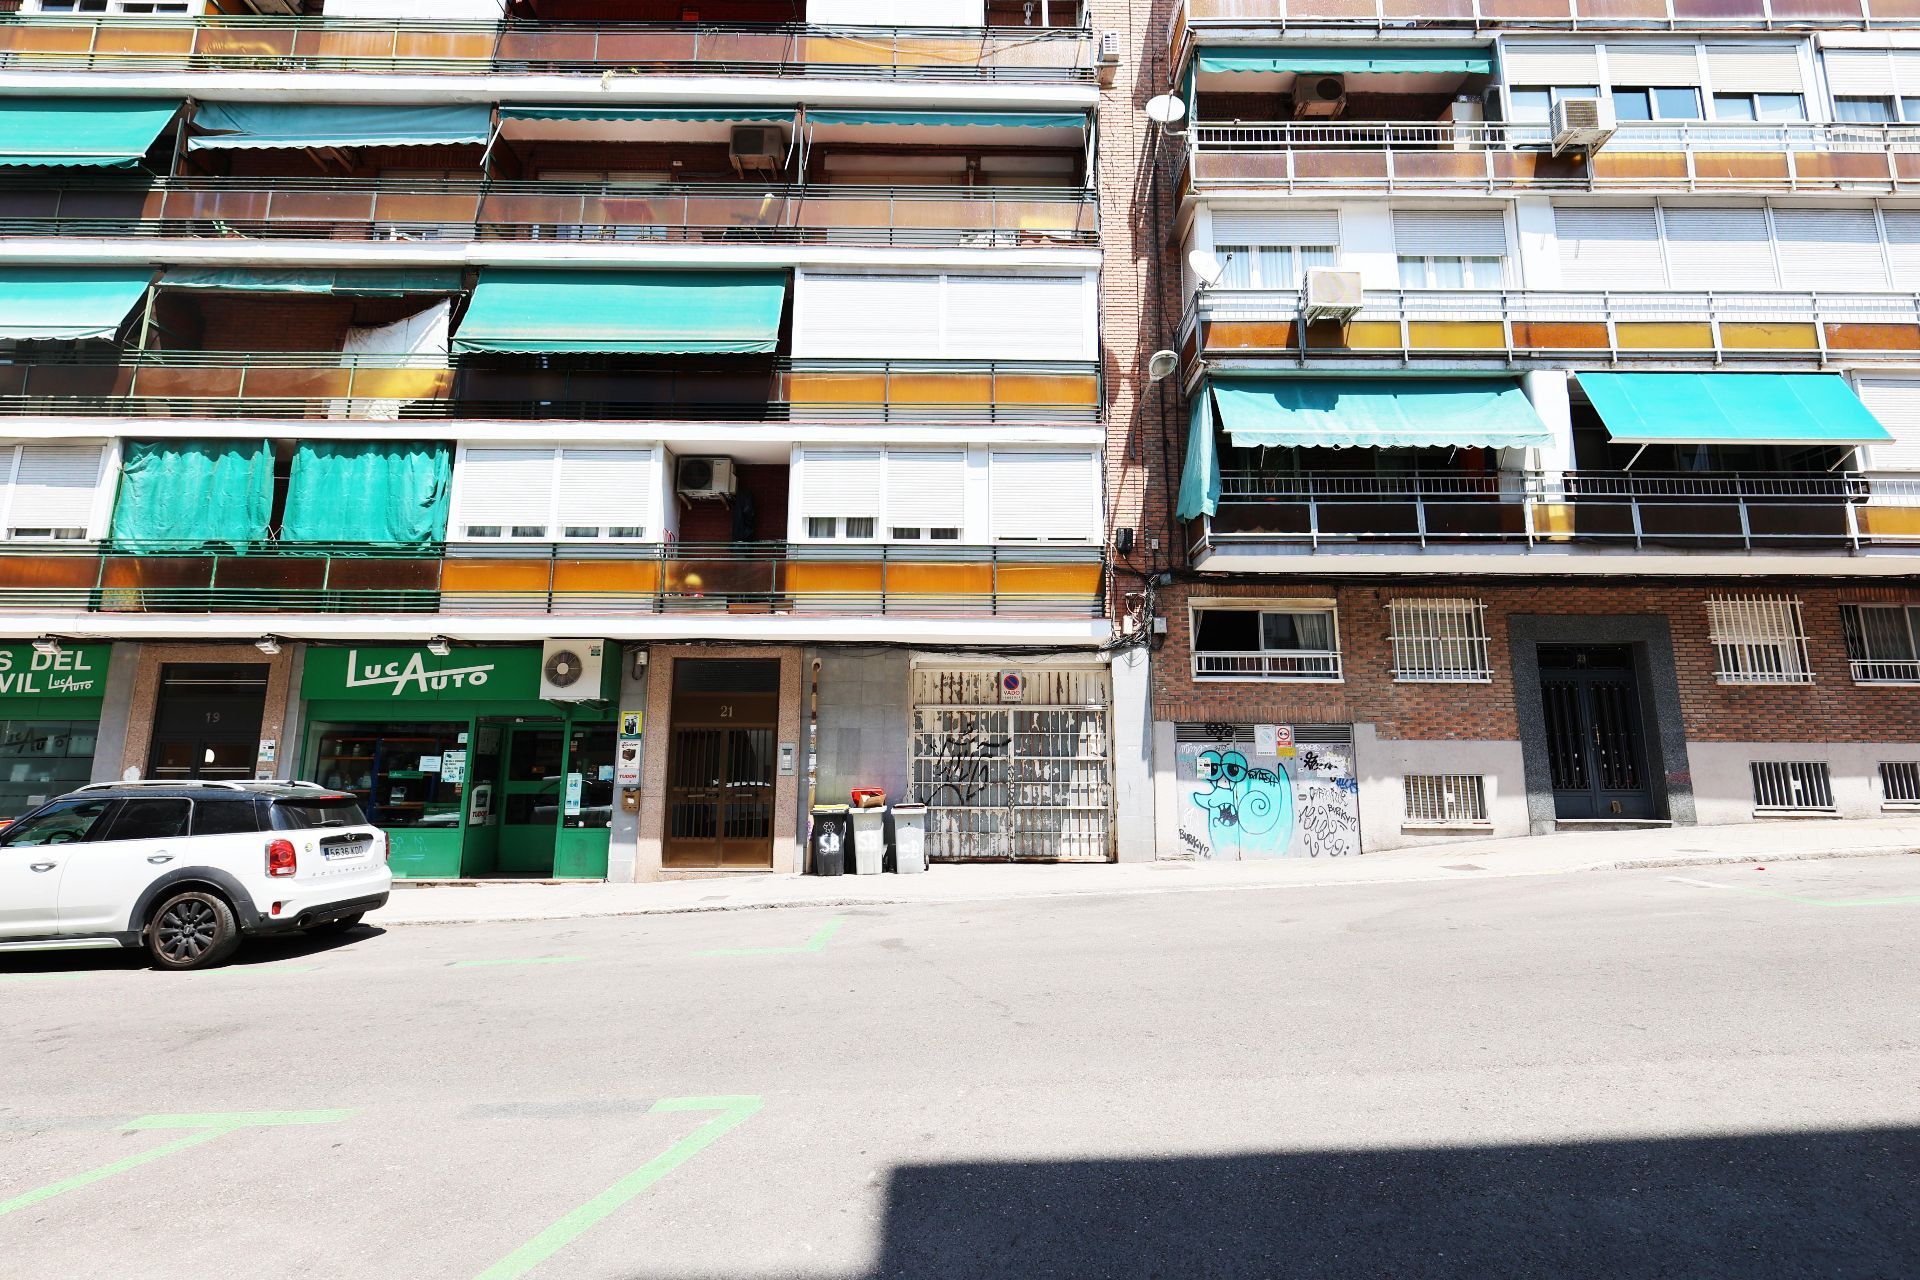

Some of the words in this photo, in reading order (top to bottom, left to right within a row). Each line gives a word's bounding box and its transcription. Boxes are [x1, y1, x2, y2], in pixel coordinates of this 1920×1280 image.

[30, 650, 92, 671] DEL
[1576, 654, 1586, 664] 23
[205, 711, 220, 723] 19
[719, 705, 734, 718] 21
[819, 833, 840, 854] SB
